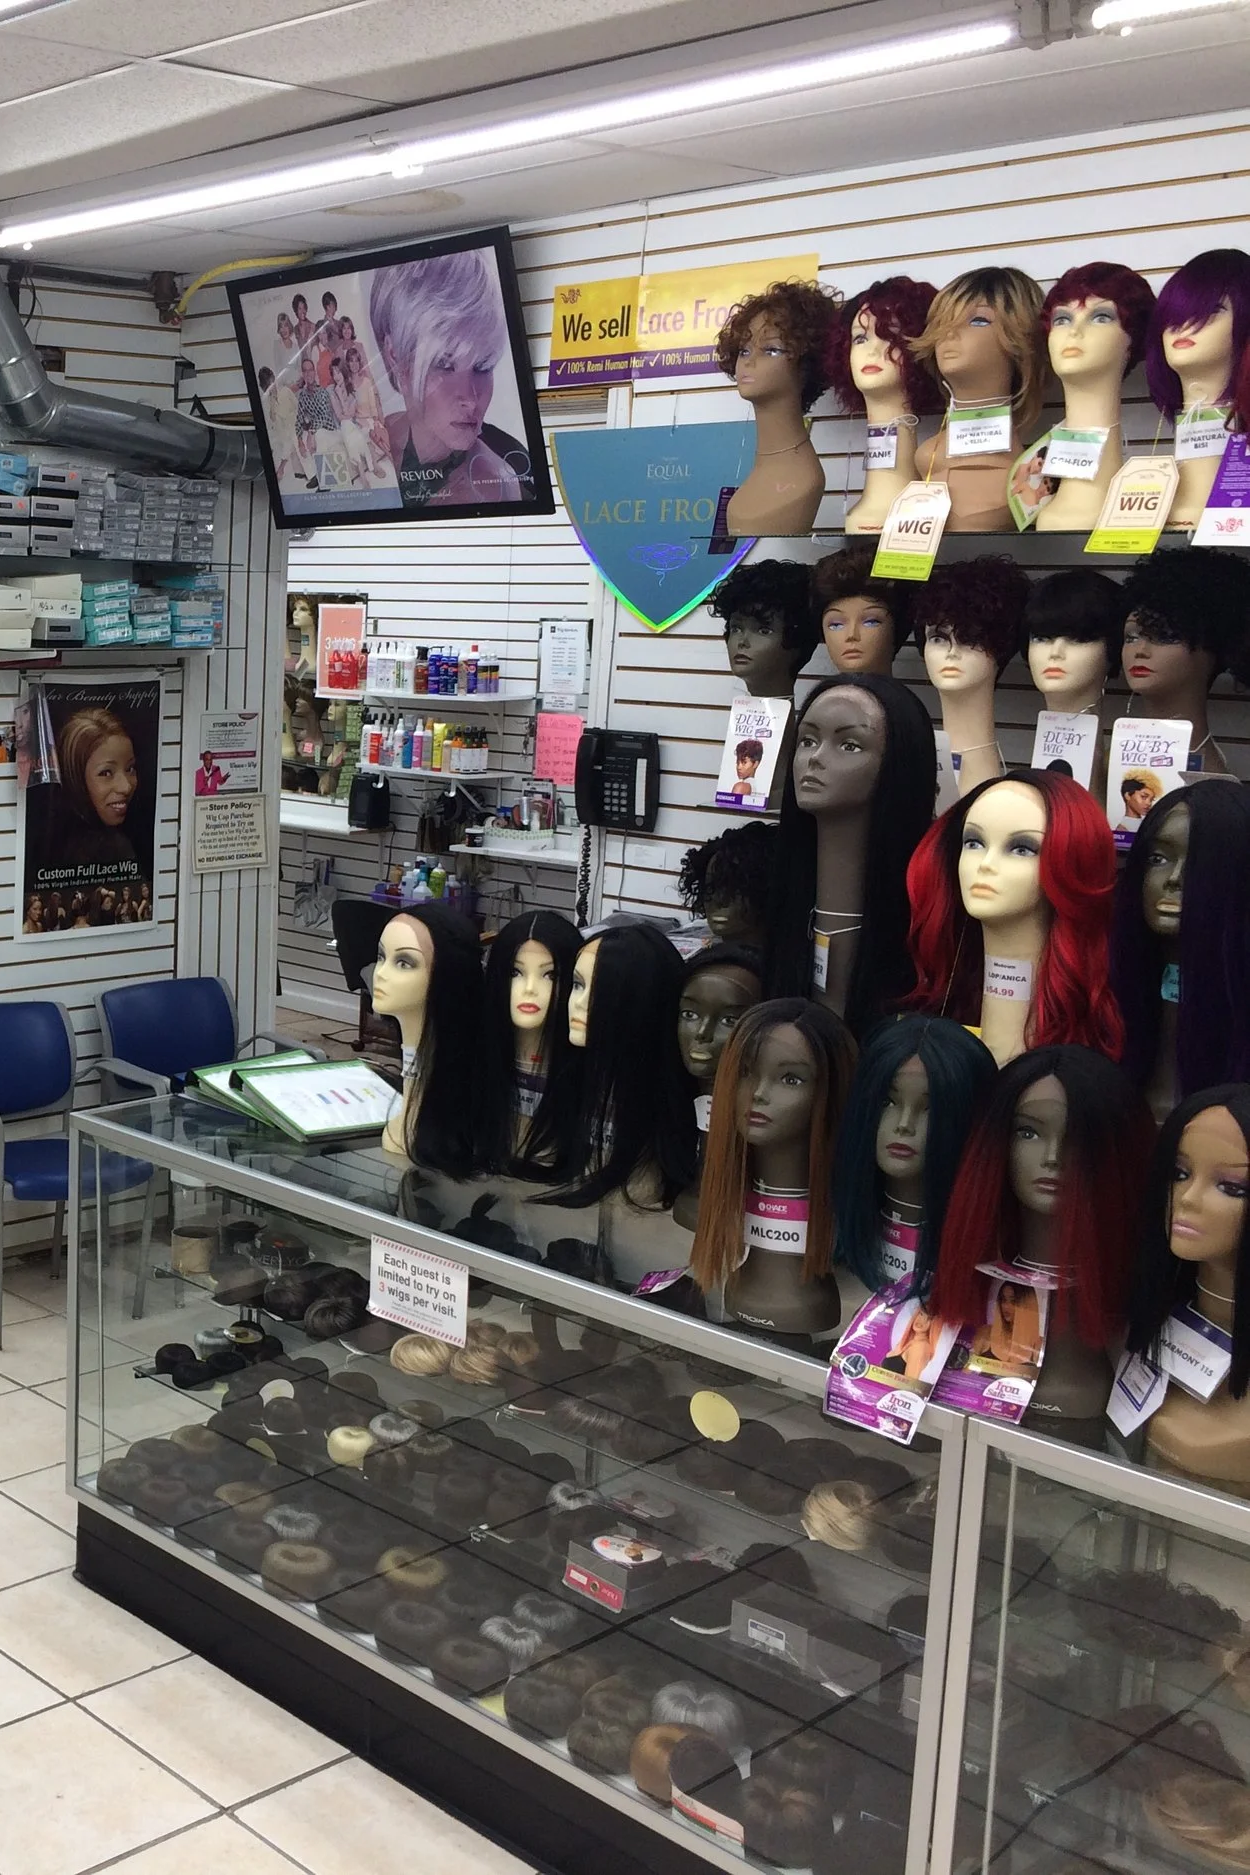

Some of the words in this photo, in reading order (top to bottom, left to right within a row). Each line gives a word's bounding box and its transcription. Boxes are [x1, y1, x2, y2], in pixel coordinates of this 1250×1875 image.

[562, 313, 592, 343] We
[598, 305, 631, 339] sell
[638, 305, 685, 335] Lace
[567, 362, 585, 374] 100%
[587, 361, 604, 373] Remi
[605, 359, 628, 371] Human
[630, 357, 645, 369] Hair
[662, 353, 681, 366] 100%
[684, 350, 710, 363] Human
[1190, 433, 1227, 443] NATURAL
[400, 469, 444, 482] REVLON
[647, 463, 691, 480] EQUAL
[583, 499, 647, 524] LACE
[1119, 496, 1159, 511] WIG
[897, 519, 933, 535] WIG
[66, 688, 116, 710] Beauty
[119, 686, 158, 709] Supply
[212, 721, 228, 729] STORE
[734, 724, 755, 734] WIG
[1043, 743, 1064, 754] WIG
[1121, 752, 1148, 764] WIG
[209, 803, 229, 811] Store
[230, 801, 252, 810] Policy
[37, 867, 75, 880] Custom
[77, 863, 96, 877] Full
[97, 863, 118, 876] Lace
[119, 860, 138, 875] Wig
[51, 881, 69, 890] Virgin
[750, 1224, 800, 1243] MLC200
[383, 1252, 408, 1271] Each
[410, 1264, 439, 1282] guest
[441, 1272, 451, 1286] is
[882, 1252, 908, 1271] C203
[378, 1265, 410, 1287] limited
[413, 1279, 423, 1291] to
[425, 1284, 440, 1300] try
[442, 1291, 456, 1303] on
[378, 1281, 385, 1293] 3
[387, 1285, 411, 1302] wigs
[412, 1295, 430, 1308] per
[432, 1302, 457, 1319] visit.
[1160, 1338, 1201, 1368] HARMONY
[985, 1388, 1006, 1400] Safe
[995, 1381, 1020, 1395] Iron
[879, 1401, 899, 1414] Safe
[889, 1393, 912, 1411] Iron
